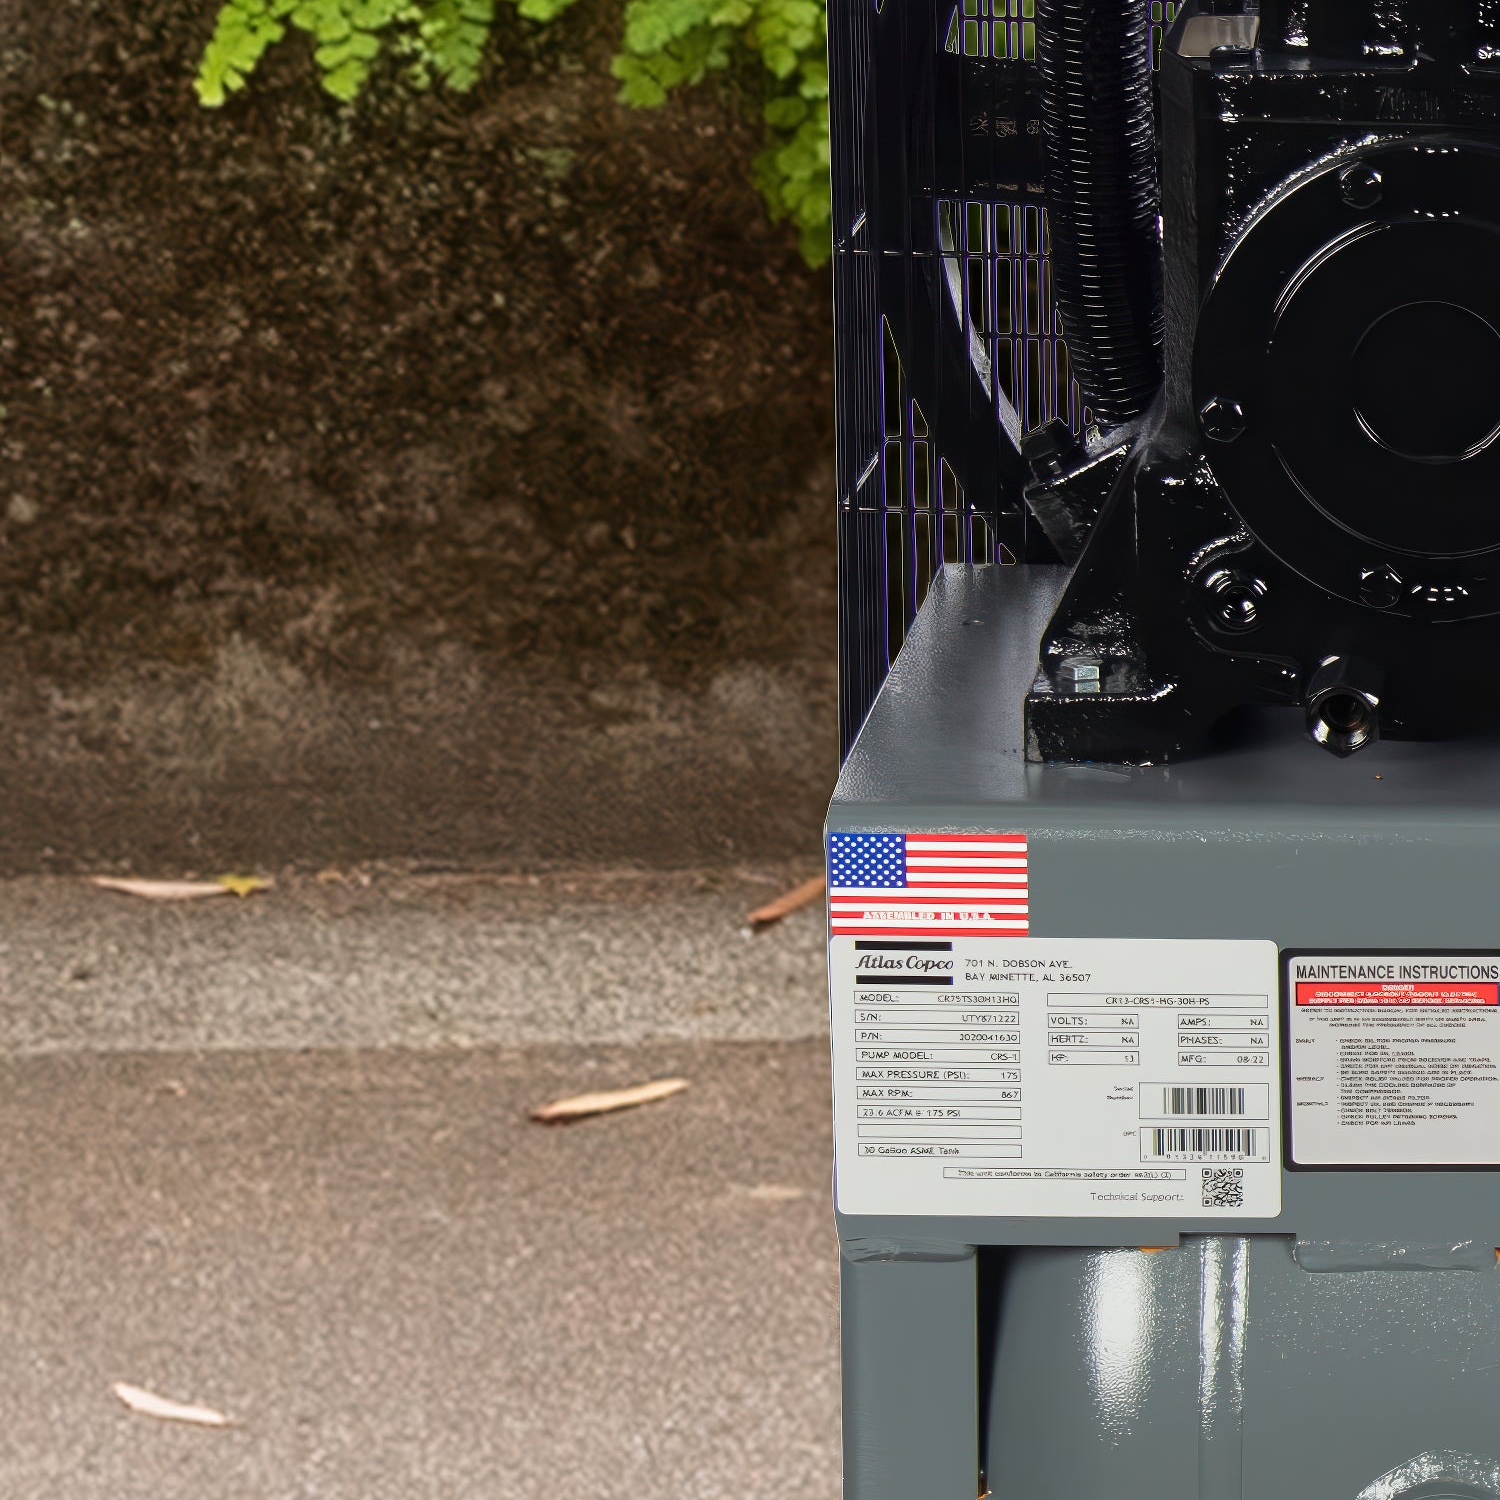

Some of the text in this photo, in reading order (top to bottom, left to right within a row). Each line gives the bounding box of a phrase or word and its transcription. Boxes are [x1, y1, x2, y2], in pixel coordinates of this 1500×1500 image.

[941, 912, 953, 920] IN
[855, 955, 953, 972] Atlas Copco
[964, 959, 983, 967] 701
[1003, 960, 1046, 968] DOBSON
[1297, 965, 1499, 979] MAINTENANCE INSTRUCTIONS
[990, 973, 1038, 982] MINETTE,
[1060, 974, 1091, 982] 36507
[860, 1013, 881, 1021] S/N:
[1051, 1017, 1088, 1025] VOLTS:
[1180, 1018, 1210, 1026] AMPS:
[861, 1032, 882, 1040] P/N:
[1051, 1035, 1089, 1043] HERTZ:
[1180, 1036, 1222, 1045] PHASES:
[944, 1071, 970, 1080] (PSI):
[1091, 1193, 1184, 1203] Technical Support:
